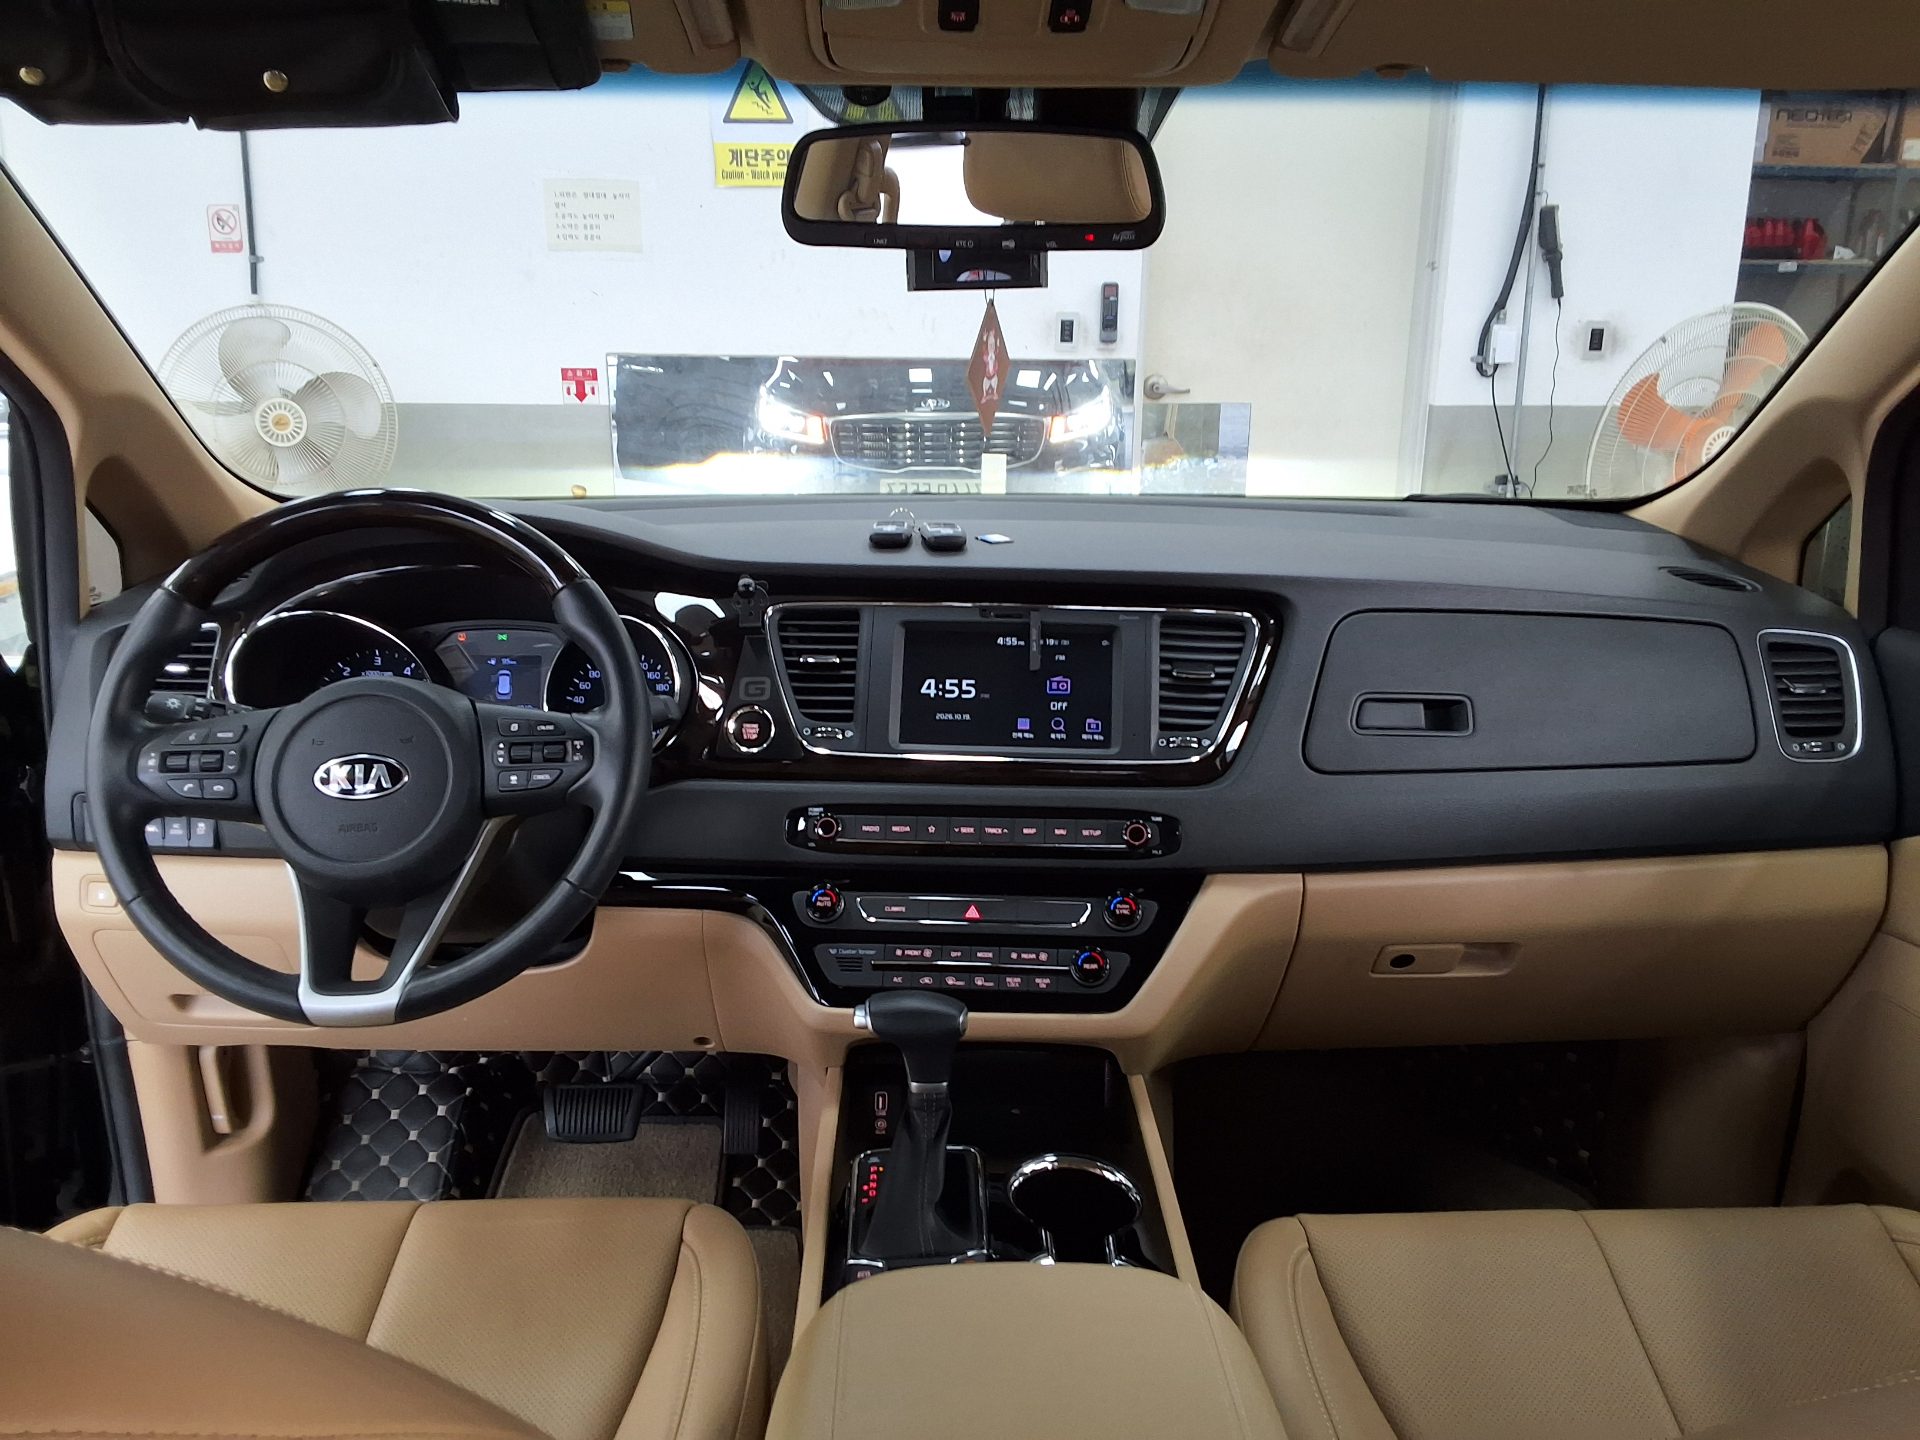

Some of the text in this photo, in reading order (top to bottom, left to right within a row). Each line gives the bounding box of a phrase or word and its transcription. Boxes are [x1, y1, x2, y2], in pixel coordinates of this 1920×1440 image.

[728, 148, 790, 167] 계단주의
[721, 168, 745, 180] Caution
[751, 169, 771, 180] Watch
[996, 636, 1018, 646] 4:55
[374, 657, 382, 666] 3
[342, 667, 351, 676] 2
[403, 666, 412, 676] 4
[589, 670, 601, 679] 80
[647, 671, 661, 680] 160
[579, 682, 591, 690] 60
[655, 683, 670, 691] 180
[920, 678, 977, 699] 4:55
[573, 696, 585, 704] 40
[1050, 701, 1068, 711] Off
[329, 763, 393, 791] KIA
[338, 822, 379, 833] AIRBAG
[862, 825, 880, 833] RADIO
[985, 827, 1002, 835] TRACK
[1022, 827, 1037, 835] MAP
[1054, 828, 1068, 836] NAV
[1082, 829, 1102, 837] SETUP
